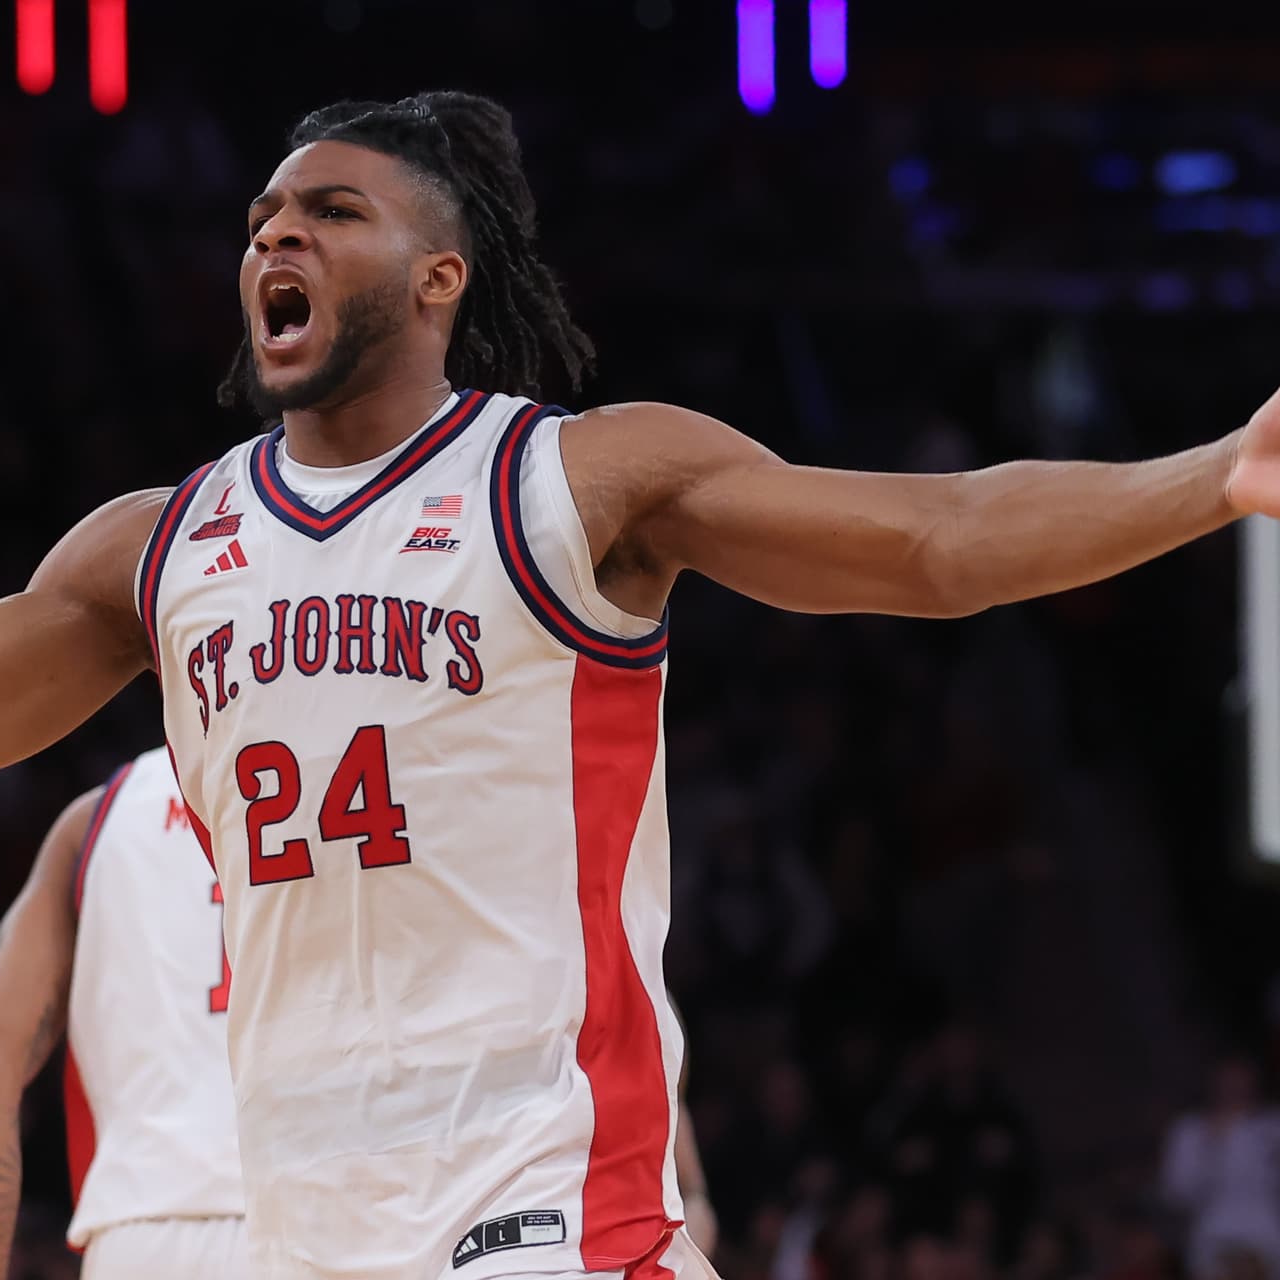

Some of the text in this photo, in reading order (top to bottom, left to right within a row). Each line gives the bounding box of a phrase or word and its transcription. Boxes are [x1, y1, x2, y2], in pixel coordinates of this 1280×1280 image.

[404, 538, 461, 550] EAST
[411, 526, 452, 538] BIG
[188, 594, 483, 739] ST. JOHN'S
[235, 725, 412, 887] 24
